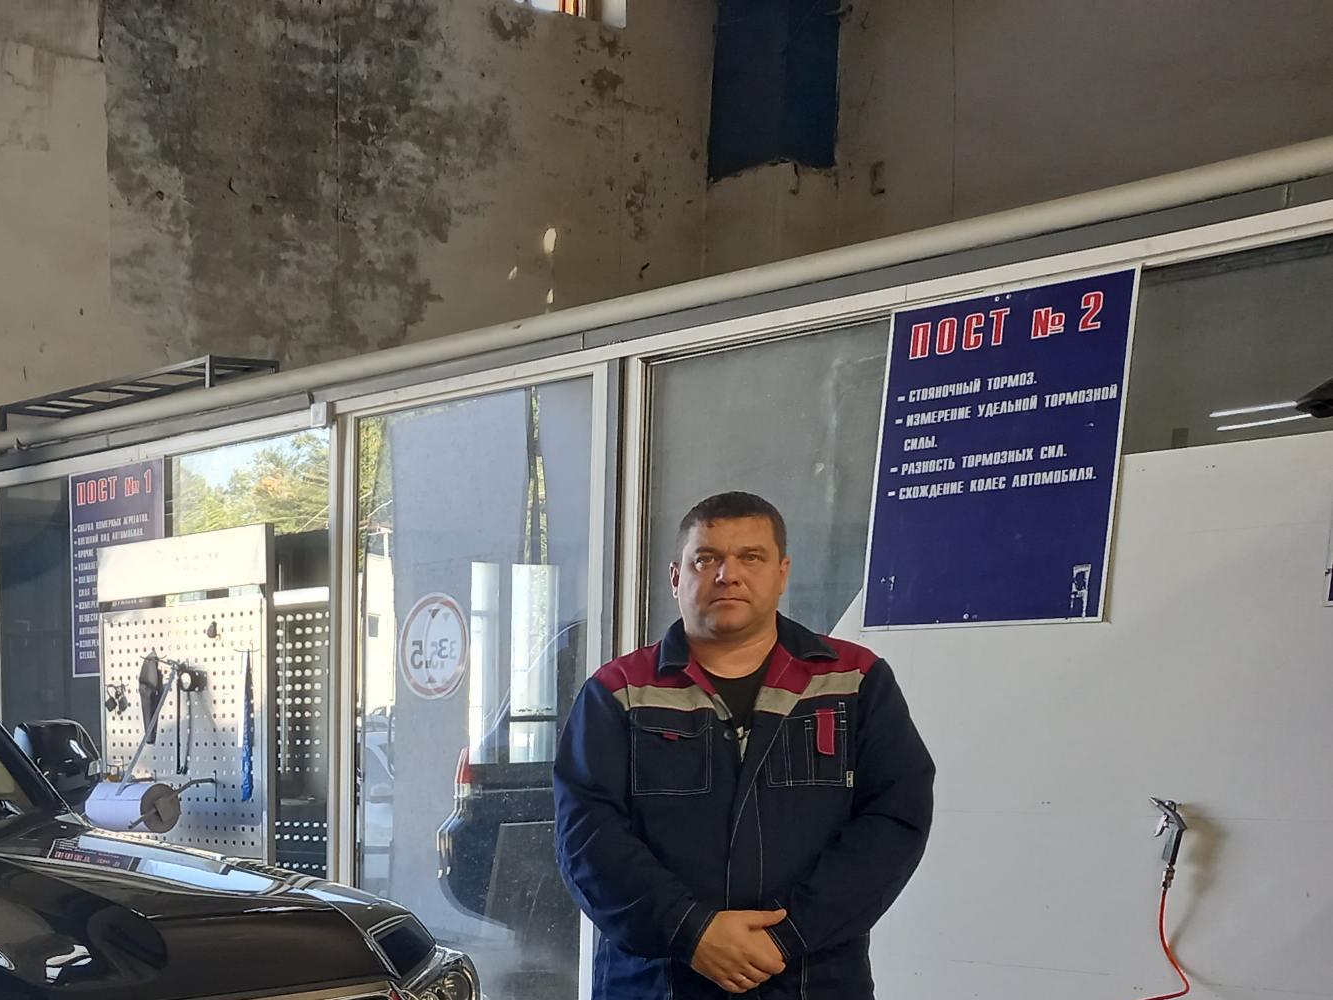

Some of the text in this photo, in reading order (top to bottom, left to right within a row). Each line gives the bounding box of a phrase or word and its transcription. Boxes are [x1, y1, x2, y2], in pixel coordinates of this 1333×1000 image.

[909, 291, 1104, 360] ПОСТ № 2
[908, 371, 1038, 403] СТОЯНОЧНЫЙ ТОРМОЗ.
[906, 383, 1118, 427] ИЗМЕРЕНИЕ УДЕЛЬНОЙ ТОРМОЗНОЙ
[901, 444, 1067, 476] РАЗНОСТЬ ТОРМОЗНЫХ СИЛ.
[903, 434, 938, 452] СИЛЫ.
[76, 475, 117, 506] ПОСТ
[143, 468, 152, 493] 1
[898, 466, 1097, 501] СХОЖДЕНИЕ КОЛЕС АВТОМОБИЛЯ.
